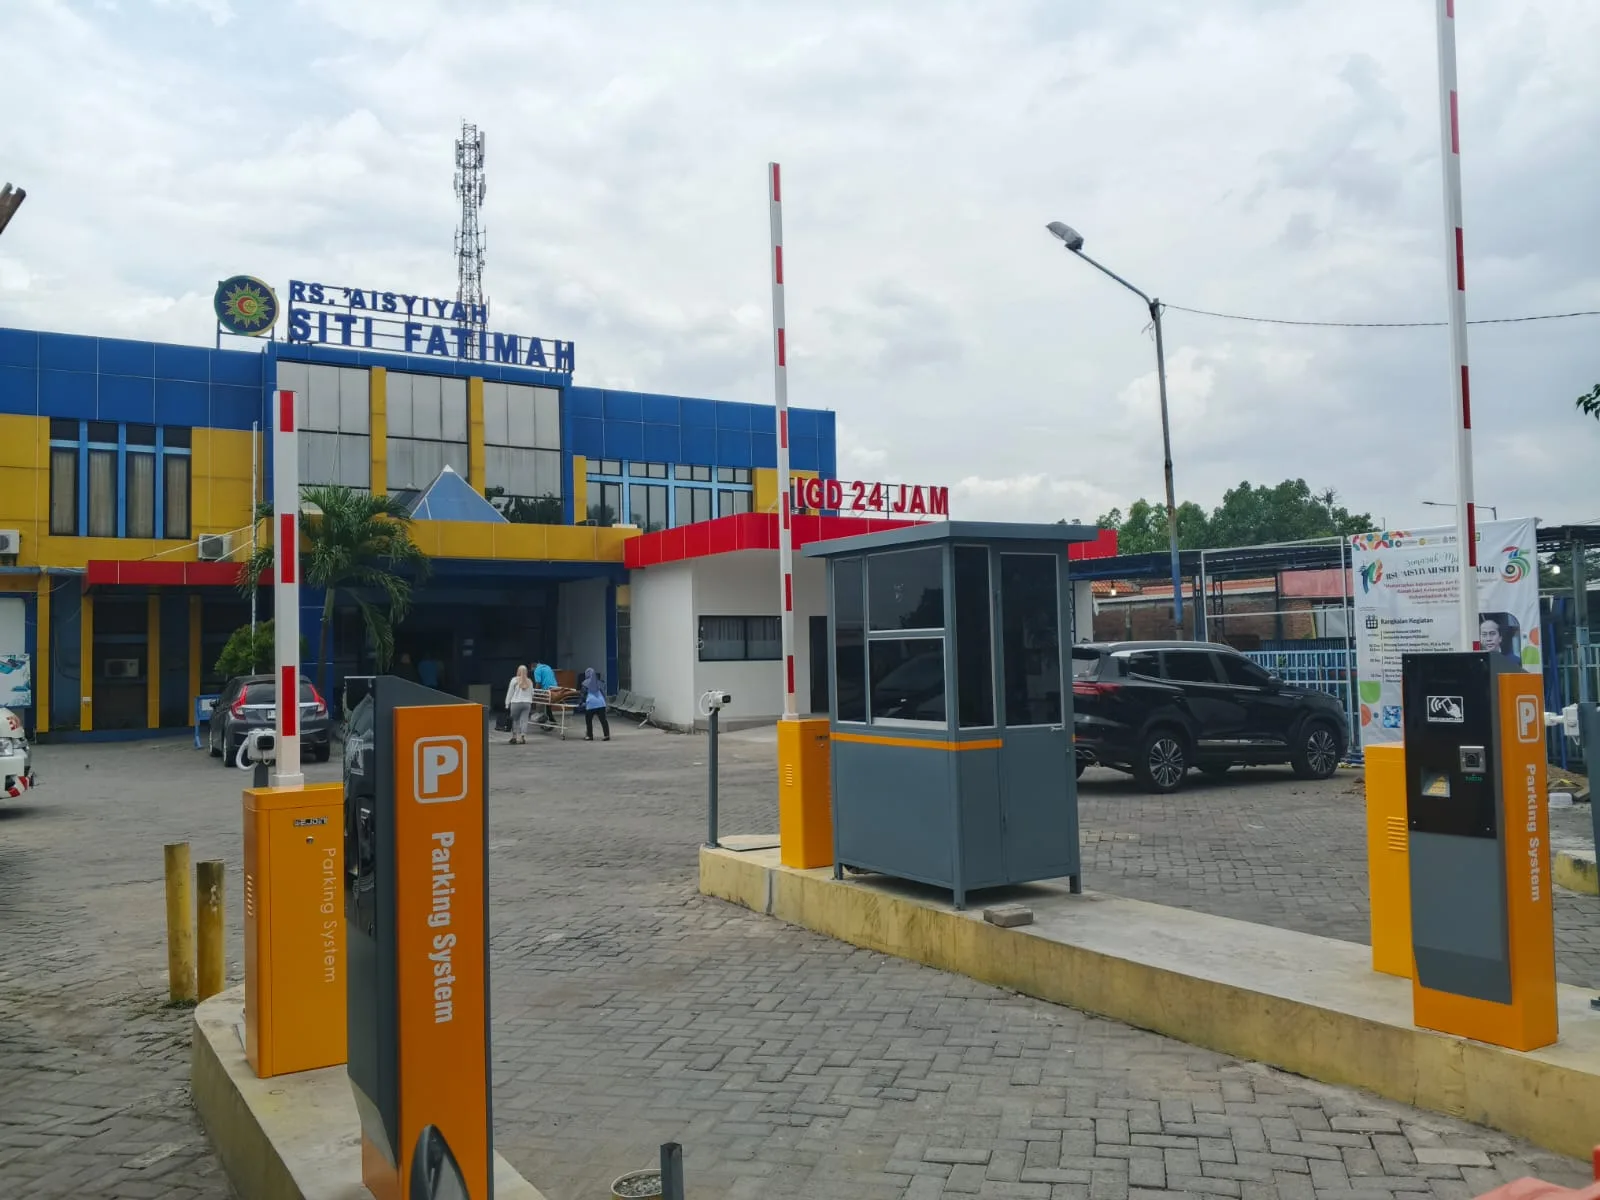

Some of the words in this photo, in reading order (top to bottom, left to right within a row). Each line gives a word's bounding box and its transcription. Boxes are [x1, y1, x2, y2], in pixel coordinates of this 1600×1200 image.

[289, 280, 334, 304] RS.
[289, 308, 373, 348] SITI
[404, 320, 575, 370] FATIMAH
[794, 477, 842, 509] IGD
[851, 480, 884, 511] 24
[893, 483, 948, 515] JAM
[1526, 763, 1539, 833] Parking
[320, 847, 337, 914] Parking
[428, 831, 457, 928] Parking
[1528, 836, 1541, 902] System
[320, 920, 338, 983] System
[428, 933, 457, 1024] System
